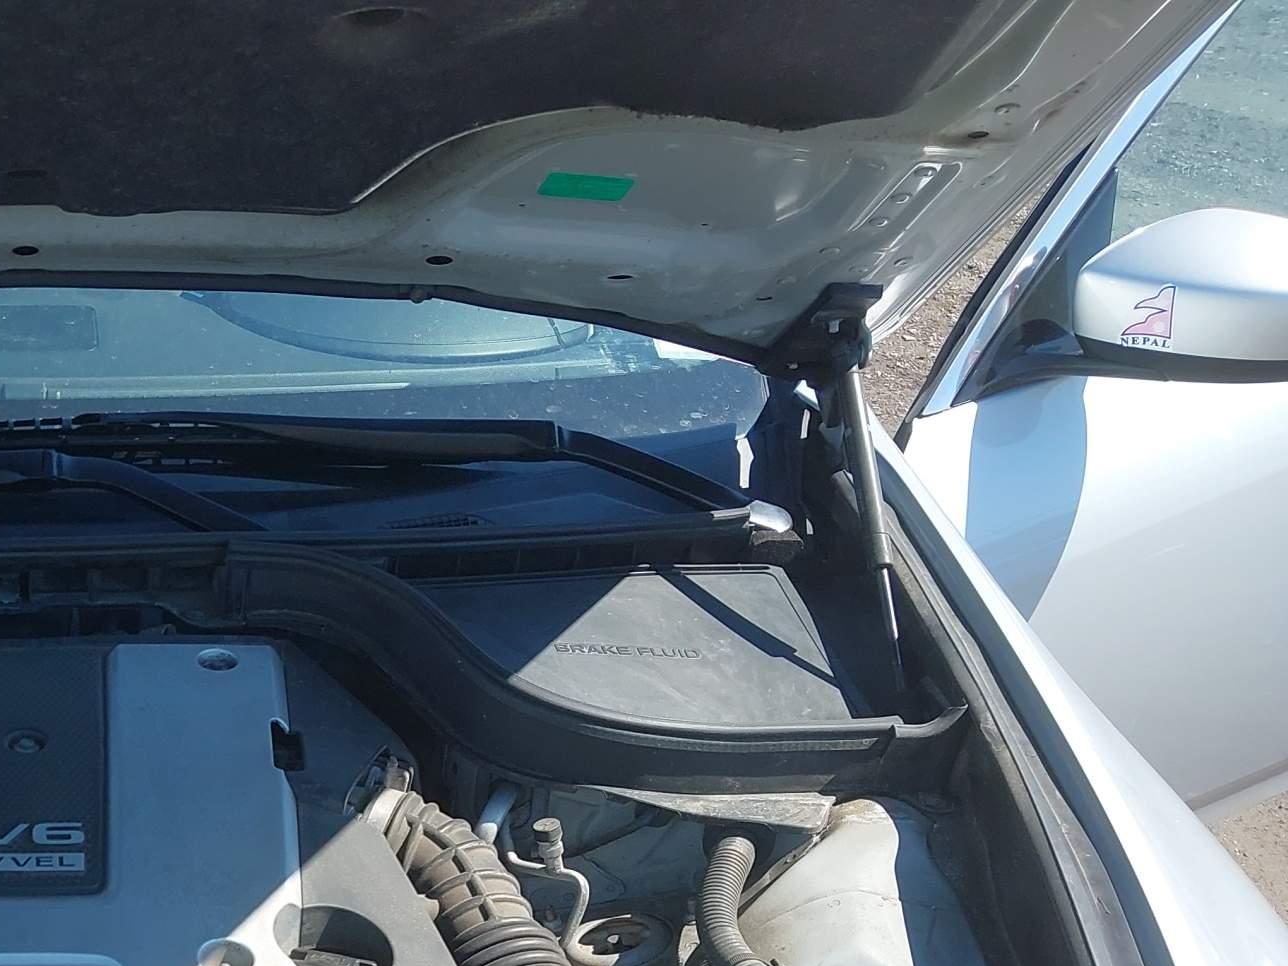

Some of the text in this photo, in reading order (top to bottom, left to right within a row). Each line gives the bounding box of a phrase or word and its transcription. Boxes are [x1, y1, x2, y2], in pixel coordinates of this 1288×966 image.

[1120, 337, 1170, 349] NEPAL
[553, 642, 701, 660] BRAKE FLUID
